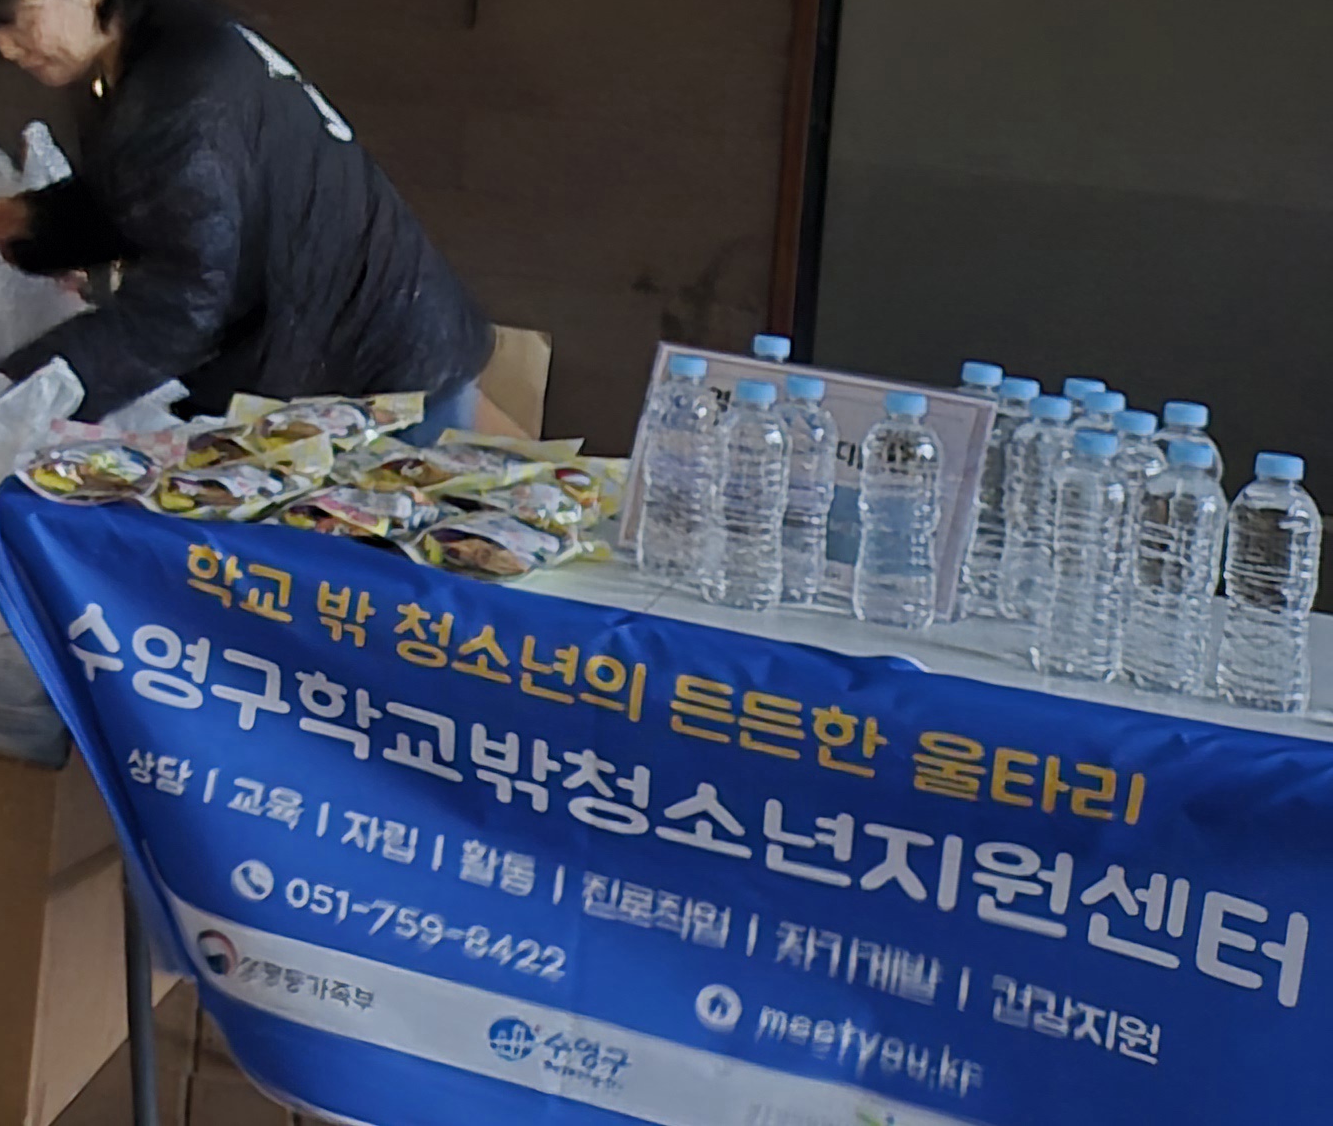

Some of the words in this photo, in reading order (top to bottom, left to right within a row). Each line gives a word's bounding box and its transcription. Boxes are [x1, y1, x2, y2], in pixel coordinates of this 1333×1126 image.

[68, 602, 1310, 1008] 수영구학교밖청소년지원센터
[187, 543, 292, 623] 학교
[316, 580, 376, 648] 밖
[394, 601, 648, 723] 청소년의
[669, 673, 889, 778] 든든한
[913, 730, 1146, 825] 울타리
[128, 748, 193, 796] 상담
[227, 777, 304, 831] 교육
[341, 810, 419, 865] 자립
[459, 839, 536, 897] 활동
[992, 973, 1161, 1065] 건강지원
[285, 877, 567, 981] 051-759-8422
[543, 1032, 632, 1076] 수영구
